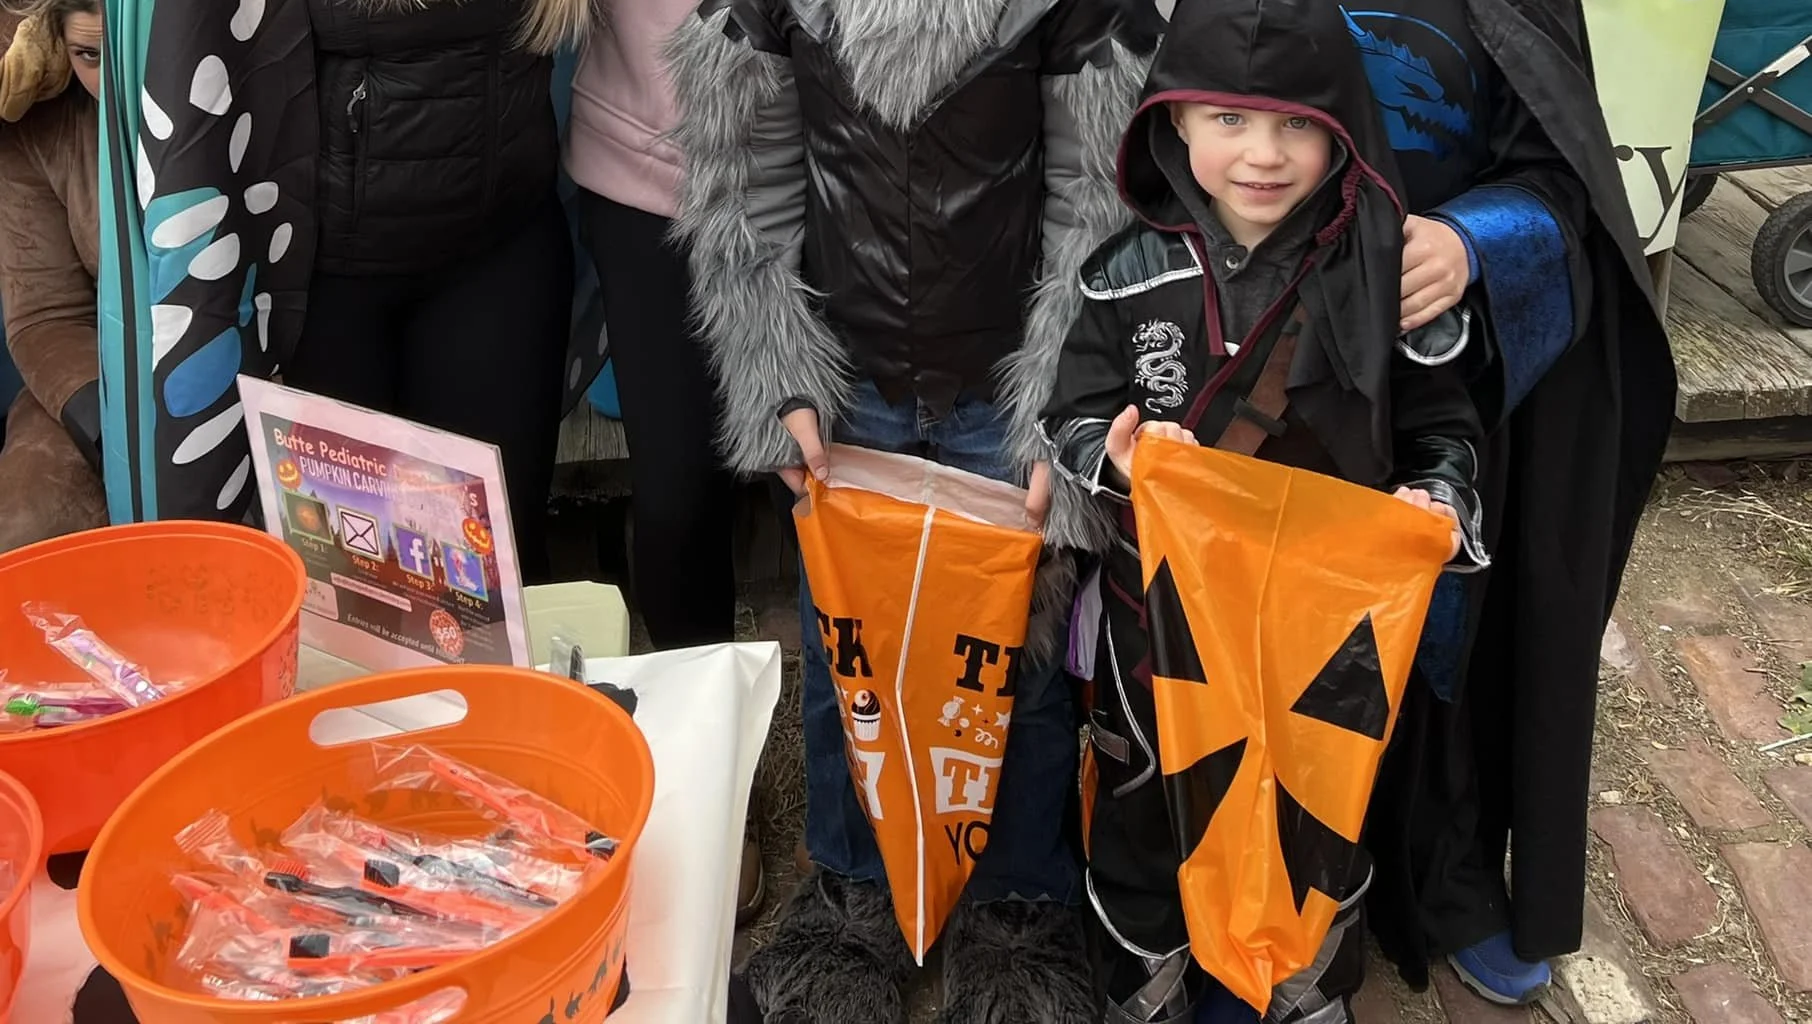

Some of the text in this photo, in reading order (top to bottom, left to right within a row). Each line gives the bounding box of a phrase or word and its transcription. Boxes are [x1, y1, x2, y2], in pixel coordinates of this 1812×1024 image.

[273, 427, 387, 476] Butte Pediatric
[299, 455, 352, 487] PUMPKIN
[351, 554, 370, 570] Step
[406, 573, 425, 588] Step
[455, 591, 474, 608] Step
